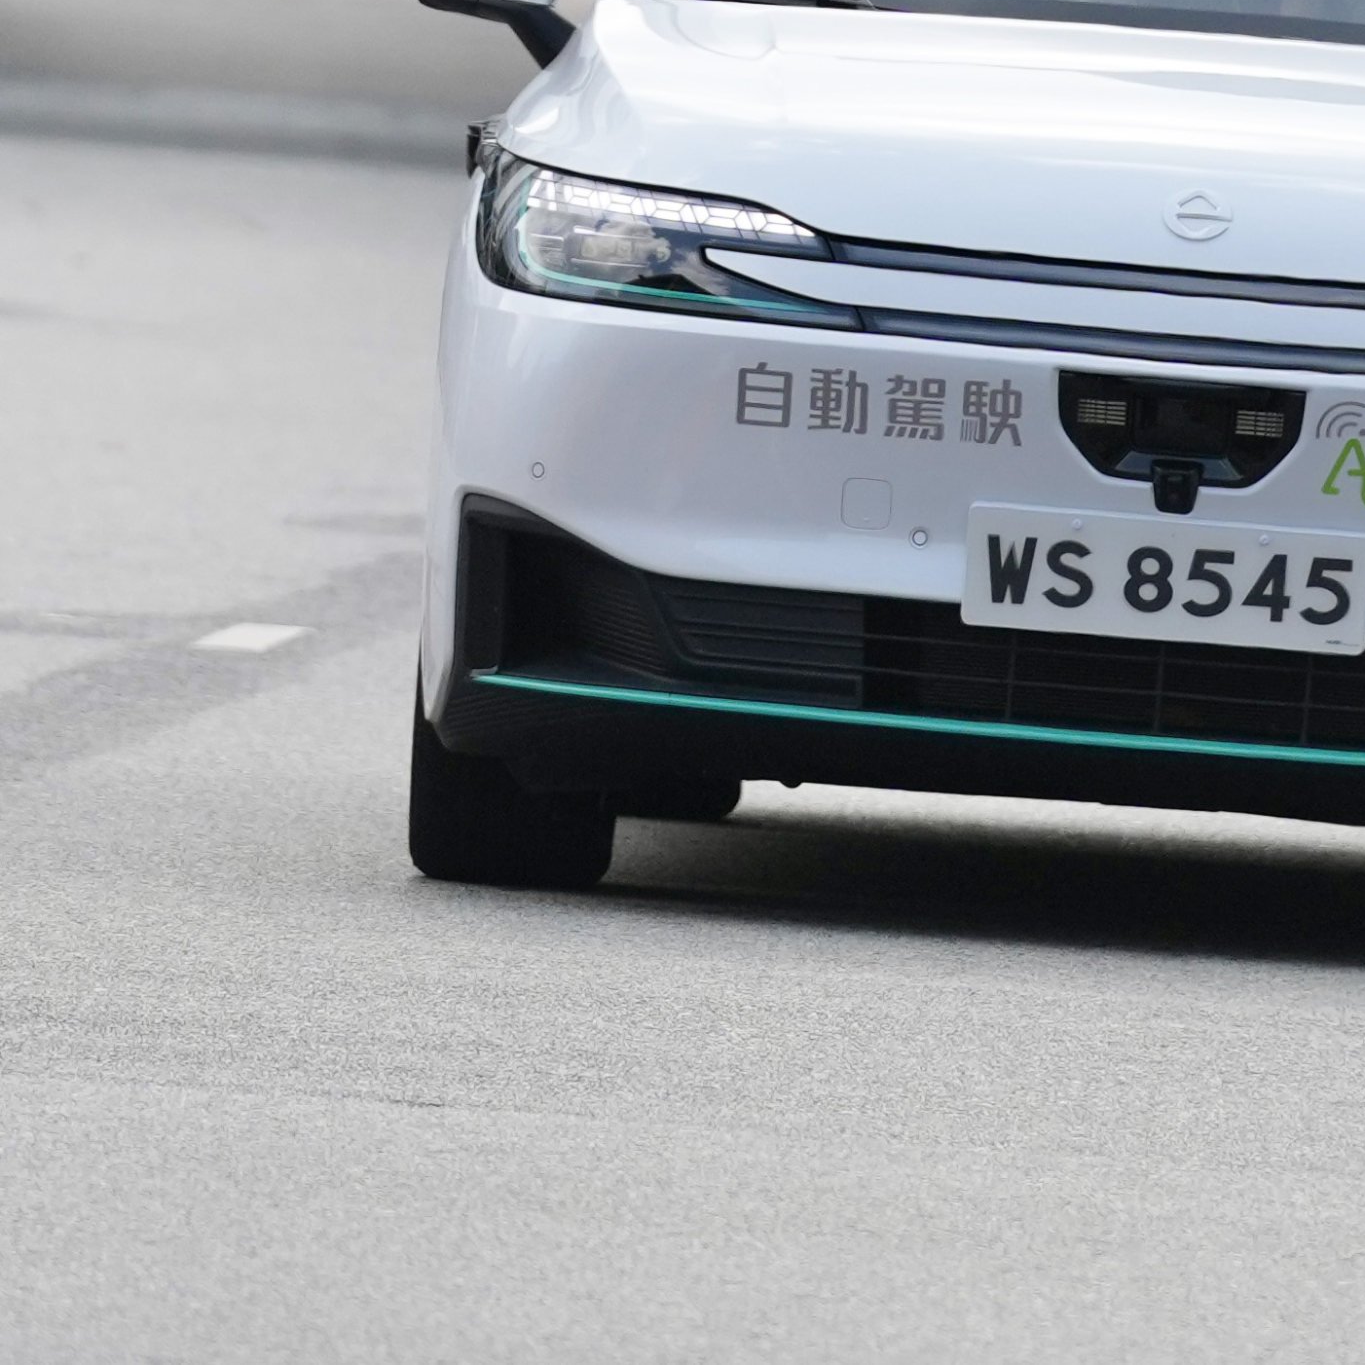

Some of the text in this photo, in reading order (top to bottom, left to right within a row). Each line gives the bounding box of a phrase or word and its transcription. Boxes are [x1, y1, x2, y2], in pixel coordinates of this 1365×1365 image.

[736, 362, 1022, 446] 自動駕駛
[987, 534, 1353, 625] WS 8545
